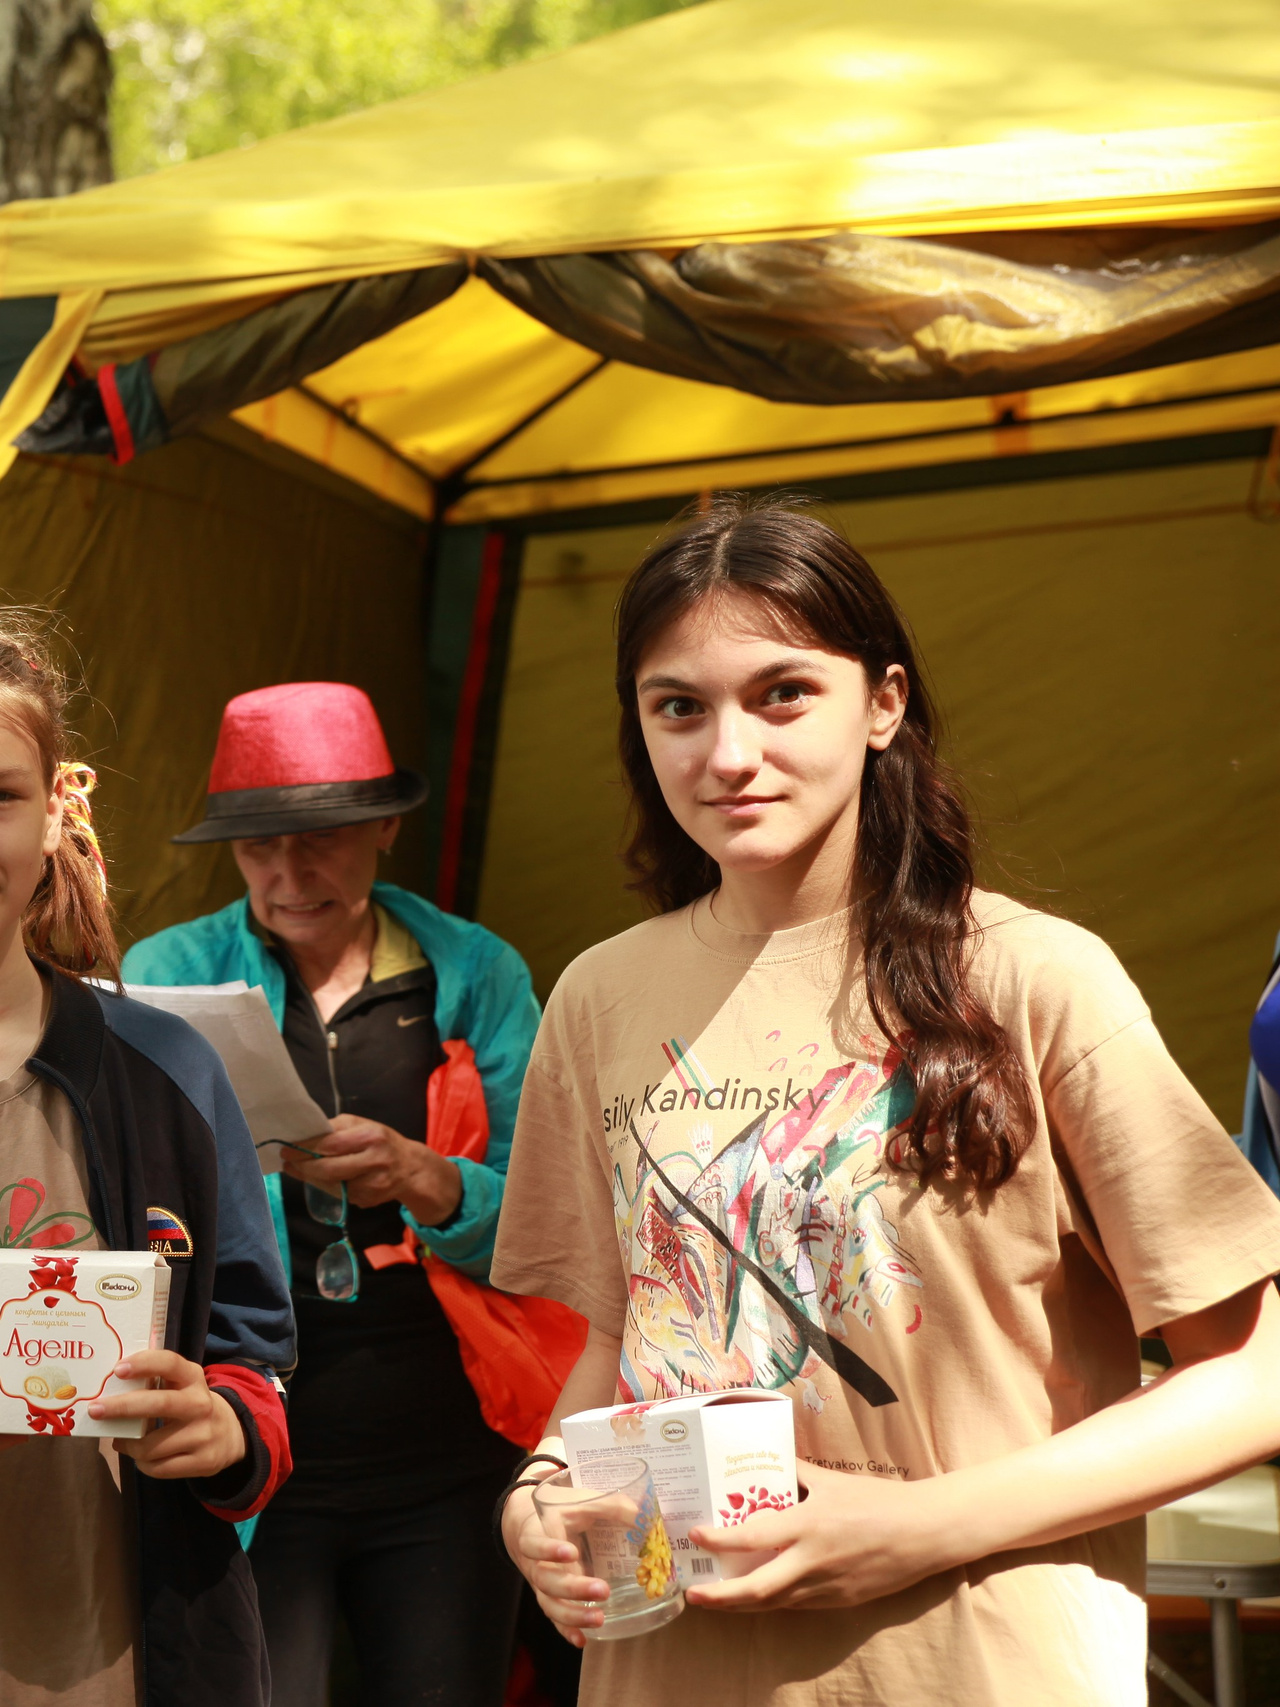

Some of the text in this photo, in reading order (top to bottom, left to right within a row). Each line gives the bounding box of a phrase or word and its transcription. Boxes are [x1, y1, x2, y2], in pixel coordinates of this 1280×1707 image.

[640, 1078, 830, 1121] Kandinsky
[14, 1308, 48, 1318] конфеты
[55, 1310, 87, 1318] цельным
[2, 1327, 95, 1366] Адель
[805, 1456, 910, 1478] Tretyakov Gallery
[676, 1537, 690, 1550] 150
